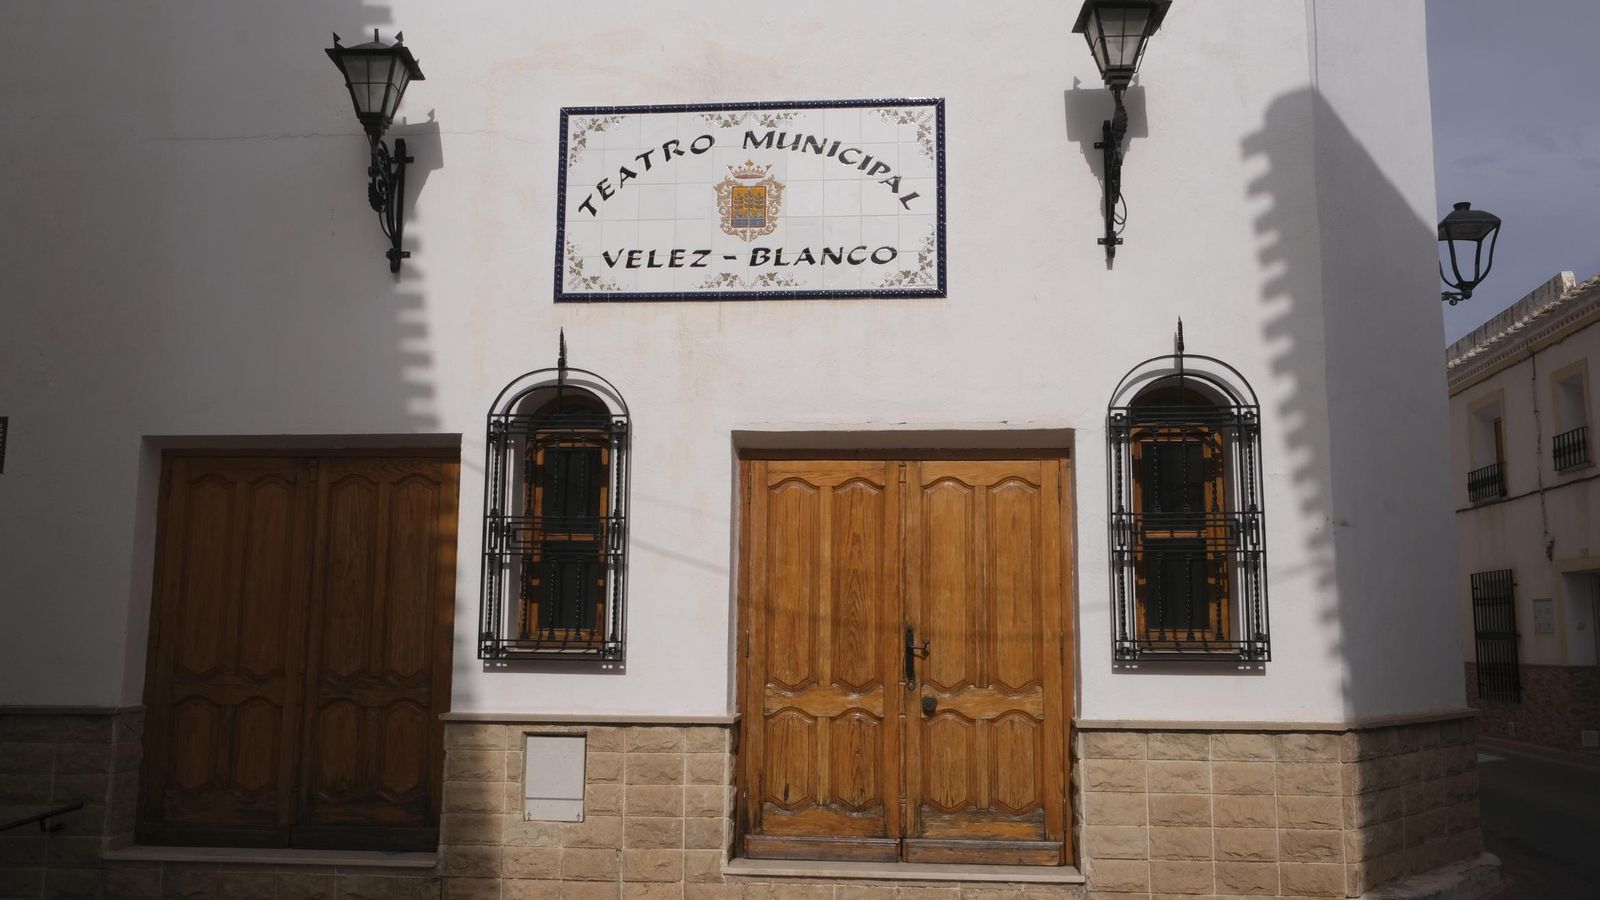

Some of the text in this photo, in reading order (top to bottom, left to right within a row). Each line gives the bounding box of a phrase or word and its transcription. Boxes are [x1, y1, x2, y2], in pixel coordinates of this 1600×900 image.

[578, 130, 921, 217] TEATRO MUNICIPAL
[602, 248, 712, 269] VELEZ
[749, 245, 898, 267] BLANCO
